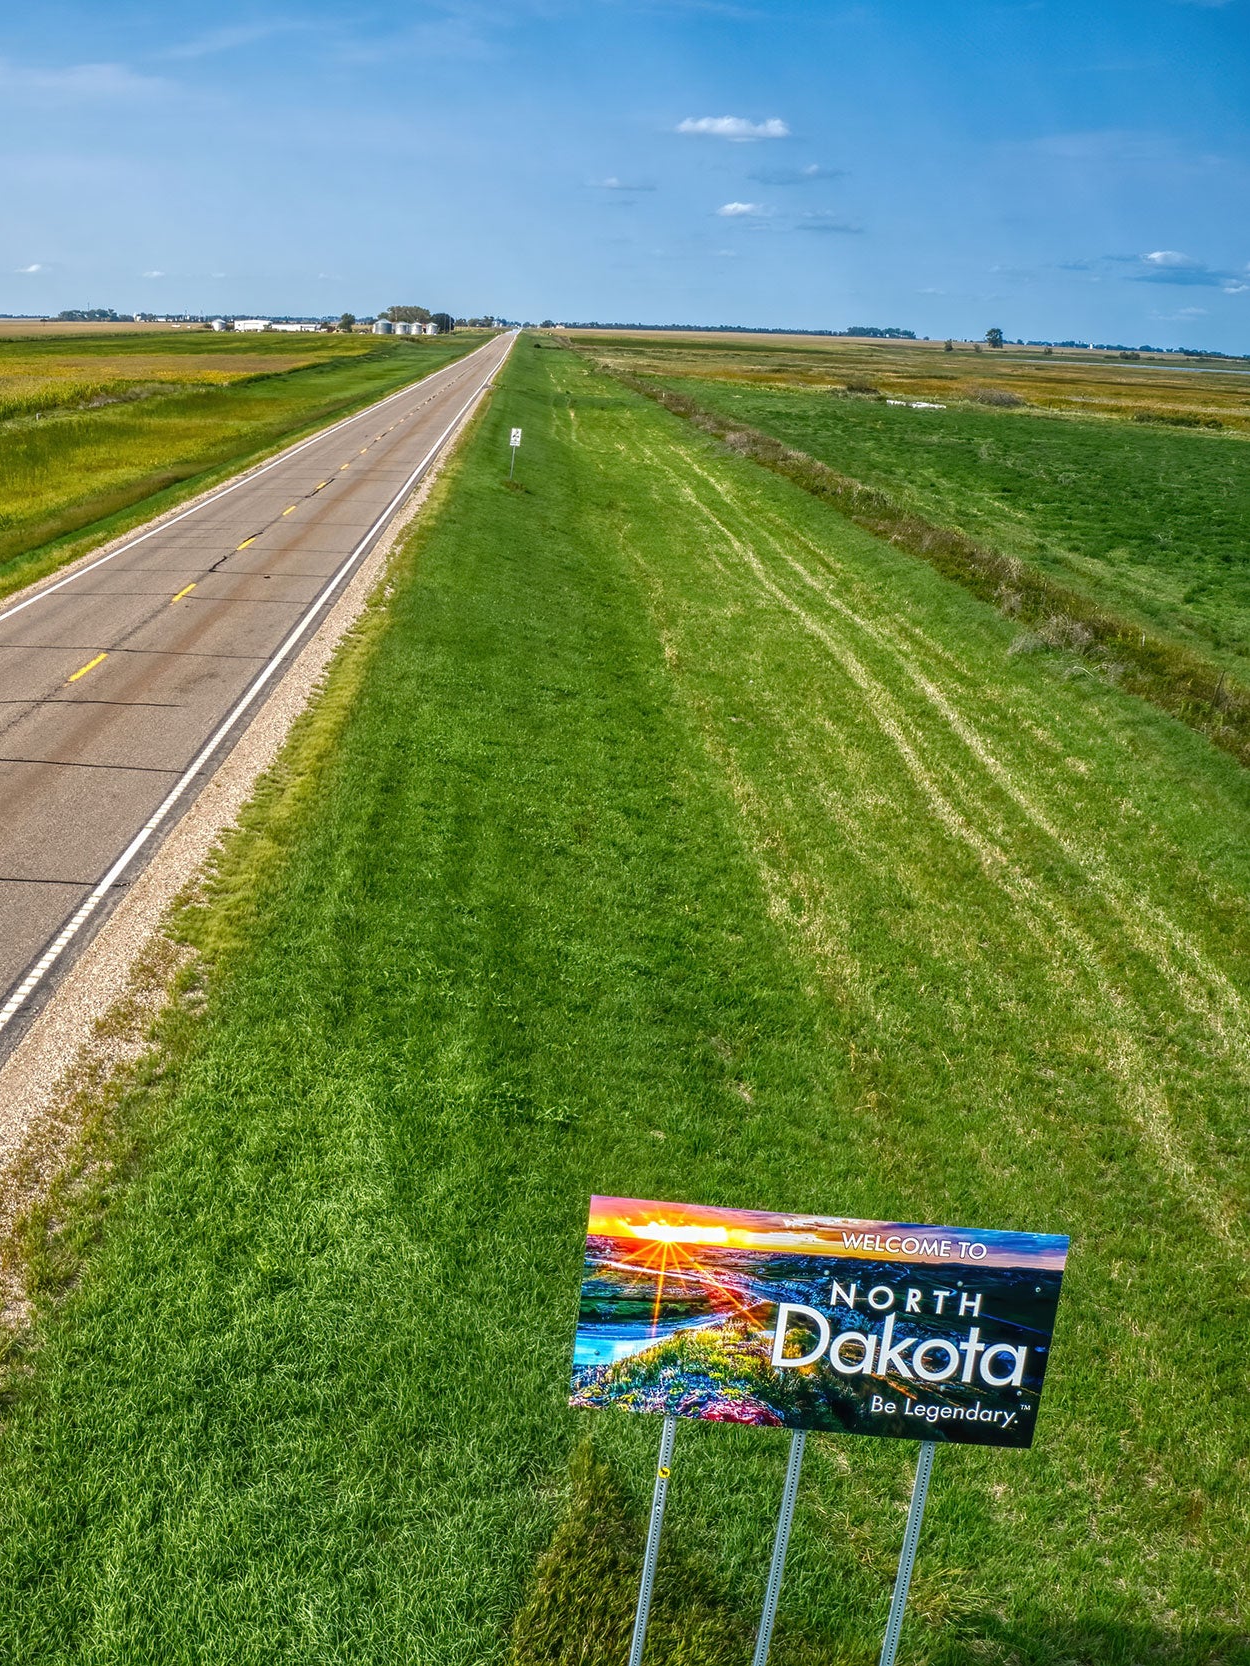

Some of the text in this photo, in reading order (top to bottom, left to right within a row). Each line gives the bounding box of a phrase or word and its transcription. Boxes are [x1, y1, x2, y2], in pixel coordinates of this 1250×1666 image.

[842, 1231, 988, 1260] WELCOME TO
[830, 1279, 983, 1318] NORTH
[771, 1303, 1027, 1387] Dakota
[871, 1395, 896, 1413] Be
[905, 1398, 1018, 1428] Legendary.
